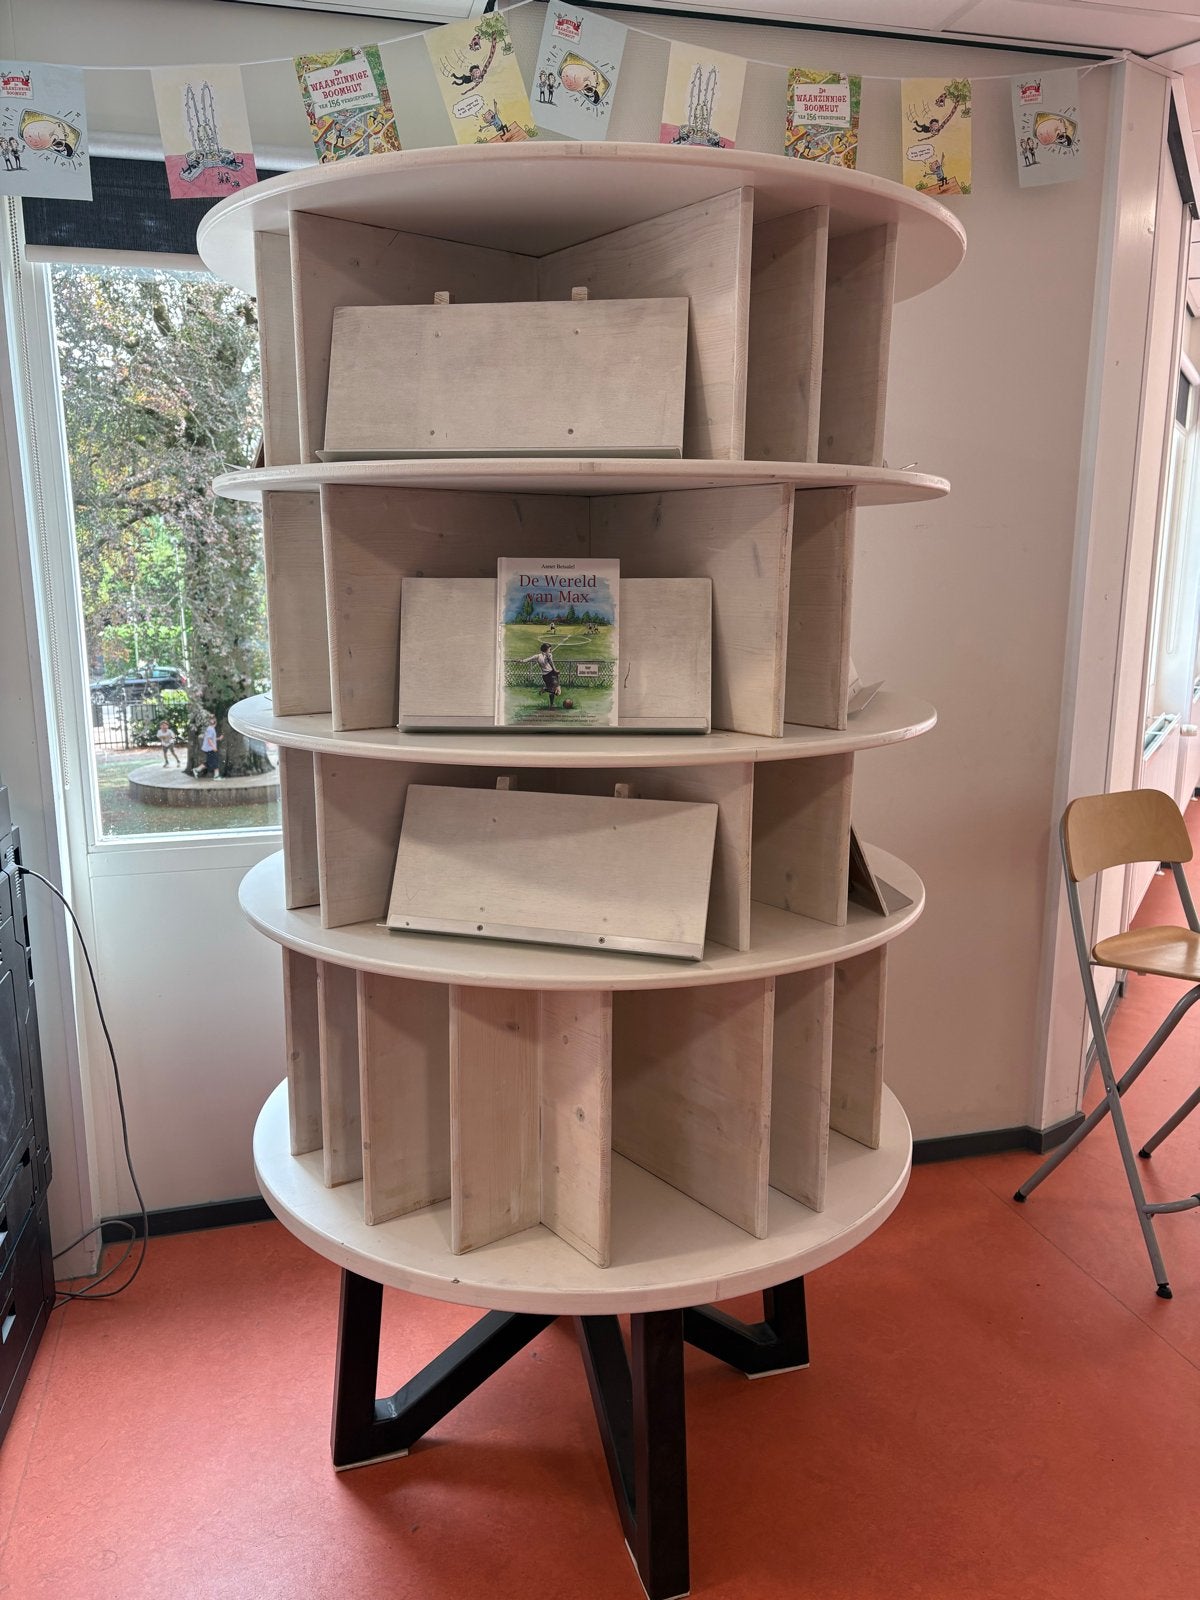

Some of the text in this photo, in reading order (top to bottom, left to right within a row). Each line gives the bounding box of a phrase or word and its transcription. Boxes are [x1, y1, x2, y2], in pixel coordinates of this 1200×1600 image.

[333, 69, 342, 77] De
[310, 70, 369, 92] WAANZINNIGE
[322, 83, 363, 99] BOOMHUT
[328, 98, 341, 108] 156
[795, 94, 848, 103] WAANZINNIGE
[804, 104, 839, 112] BOOMHUT
[807, 113, 817, 121] 156
[519, 574, 597, 588] De Wereld
[525, 590, 589, 603] van Max
